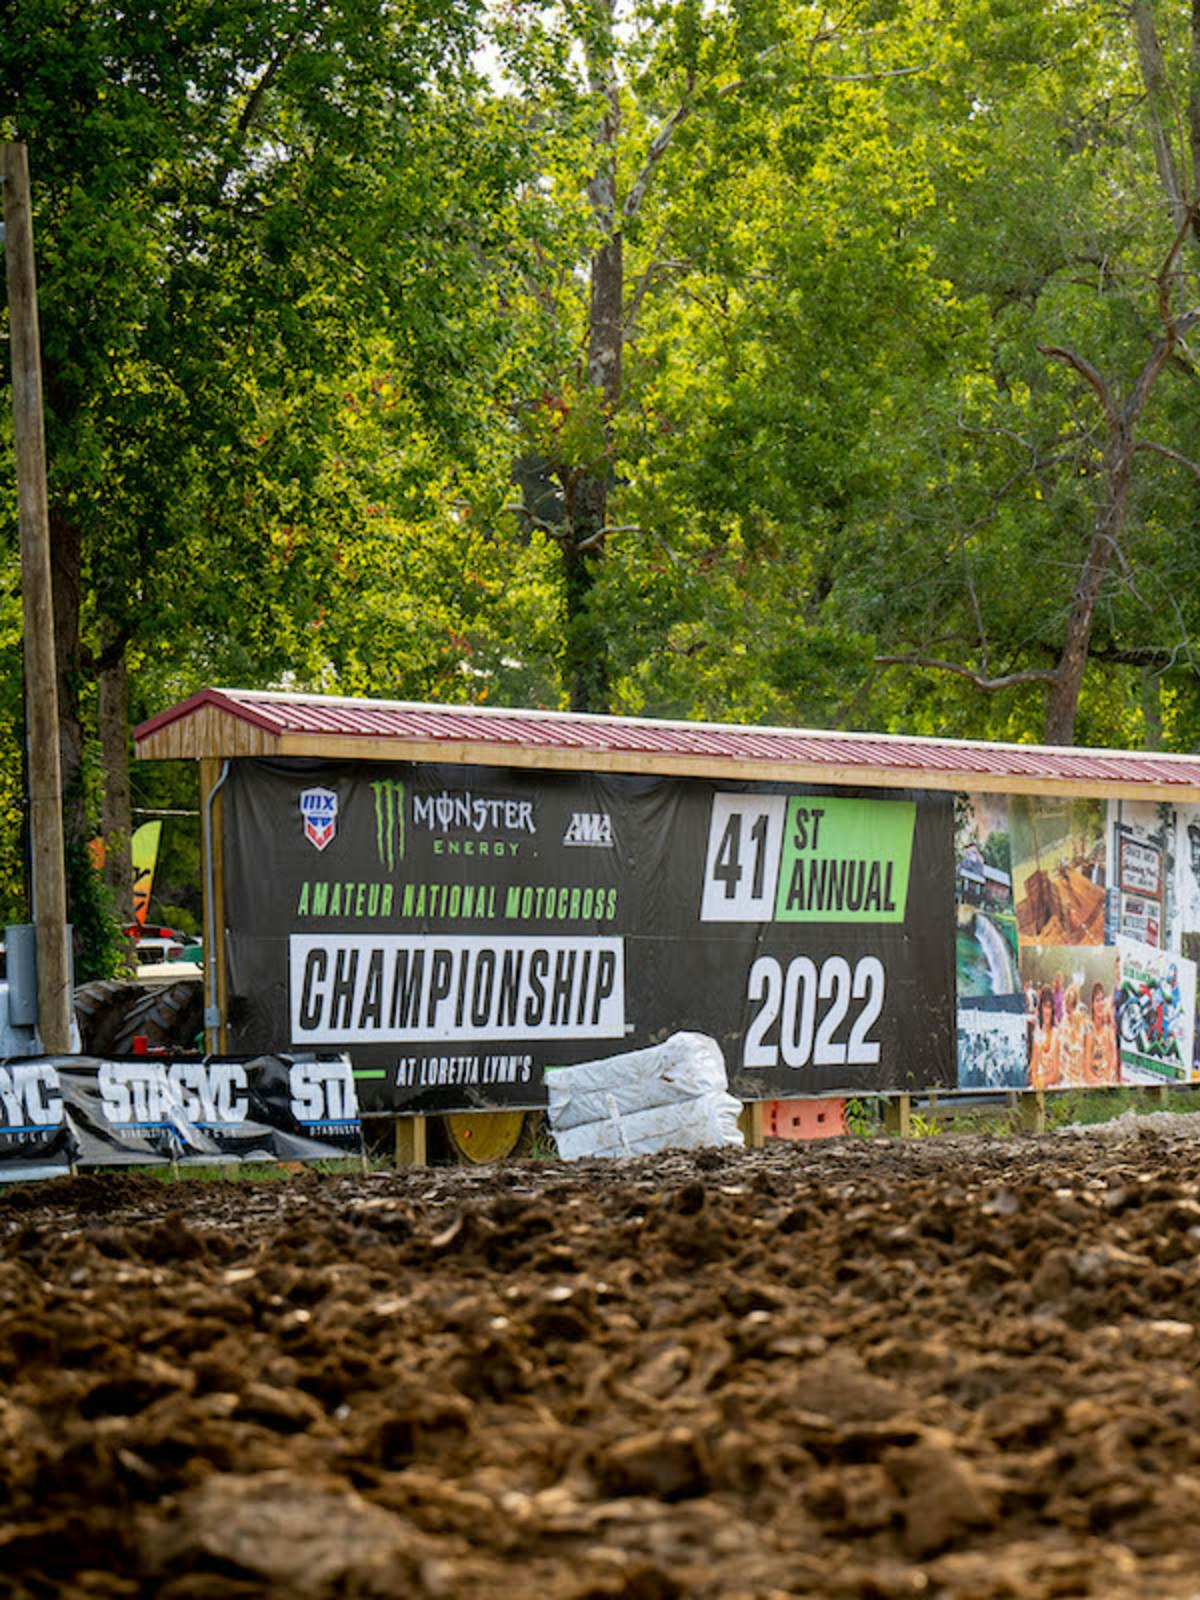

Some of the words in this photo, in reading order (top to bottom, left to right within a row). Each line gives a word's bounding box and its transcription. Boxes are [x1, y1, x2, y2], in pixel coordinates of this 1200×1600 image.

[413, 790, 536, 834] MONSTER
[563, 812, 614, 847] AMA
[794, 808, 825, 850] ST
[433, 839, 520, 857] ENERGY
[713, 813, 770, 899] 41
[298, 881, 394, 917] AMATEUR
[401, 884, 496, 919] NATIONAL
[505, 887, 618, 920] MOTOCROSS
[786, 859, 896, 912] ANNUAL
[300, 947, 616, 1031] CHAMPIONSHIP
[743, 955, 885, 1069] 2022
[396, 1057, 416, 1086] AT
[420, 1057, 479, 1085] LORETTA
[482, 1055, 532, 1083] LYNN'S
[98, 1062, 250, 1124] STACYC
